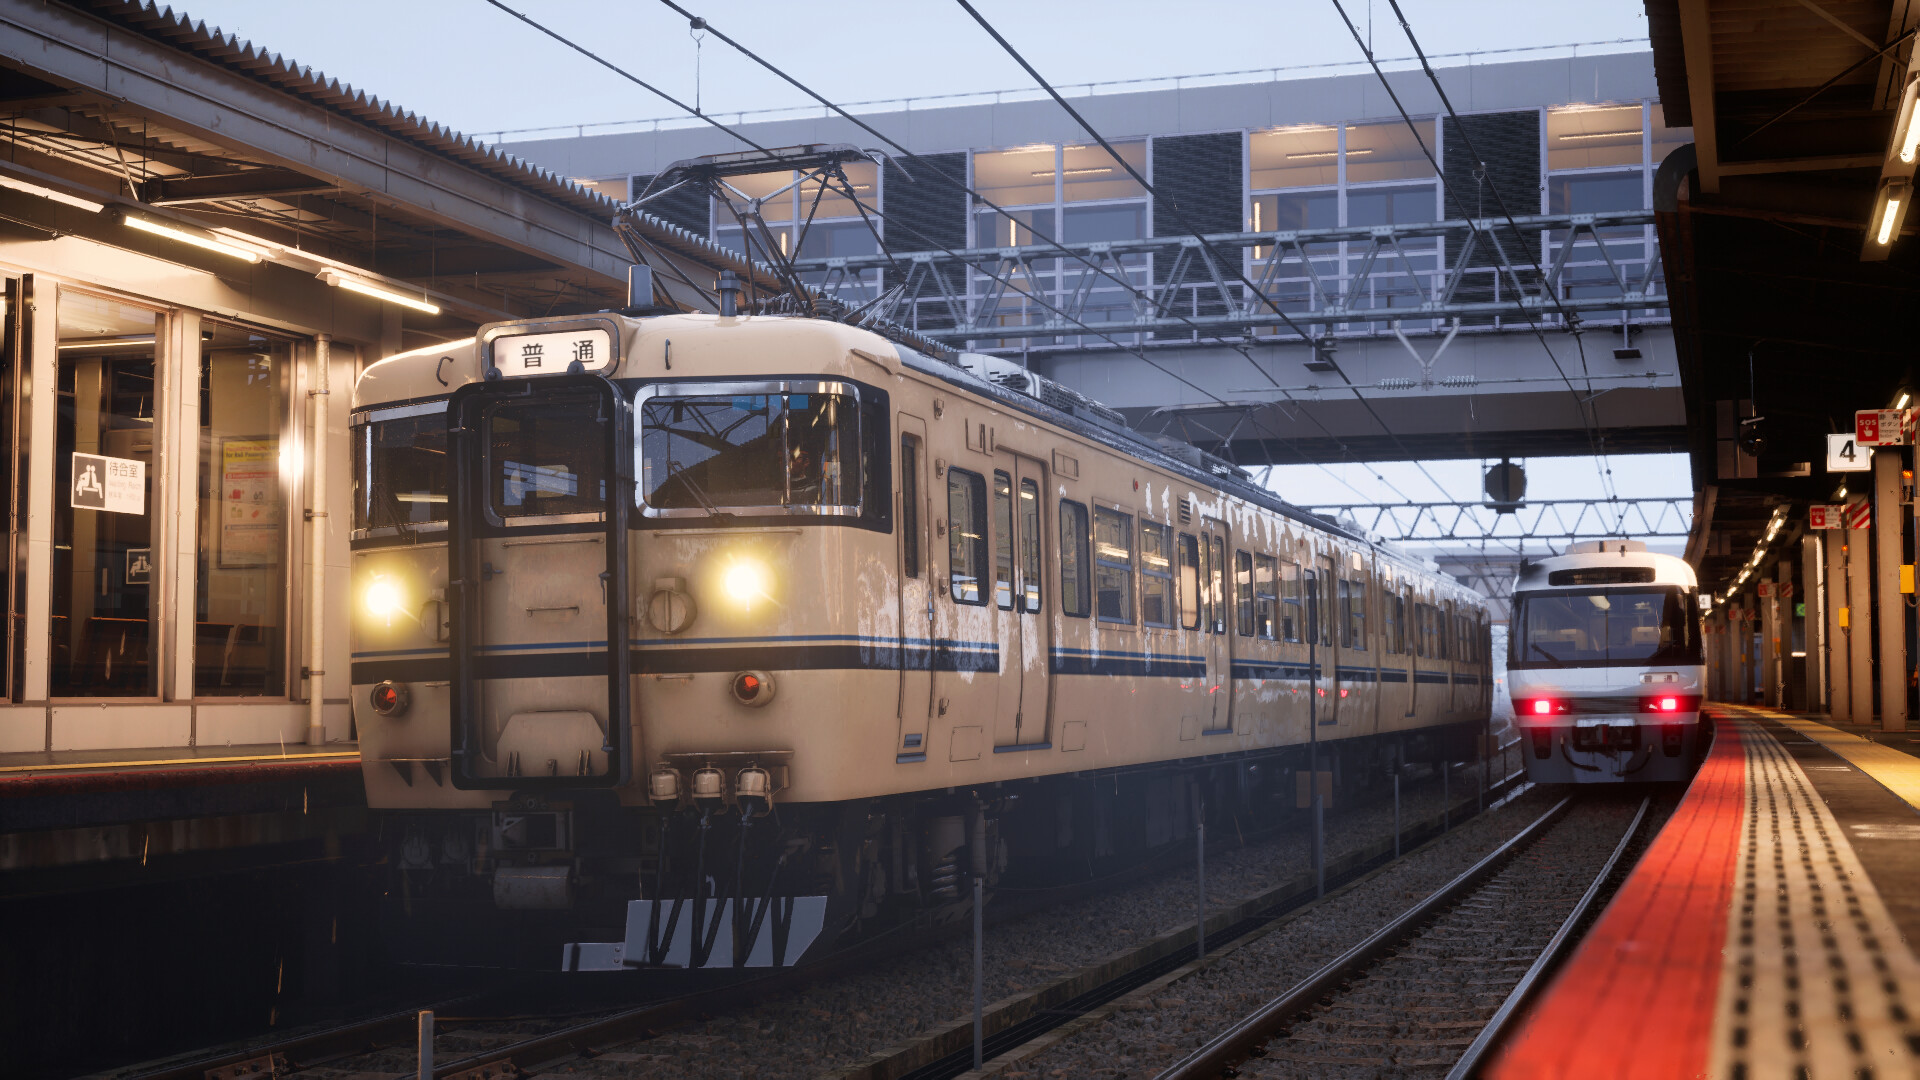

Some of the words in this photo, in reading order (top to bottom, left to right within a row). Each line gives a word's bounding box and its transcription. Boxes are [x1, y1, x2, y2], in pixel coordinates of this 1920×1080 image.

[521, 340, 595, 368] 普通
[1839, 440, 1857, 462] 4
[109, 461, 138, 478] 待合室
